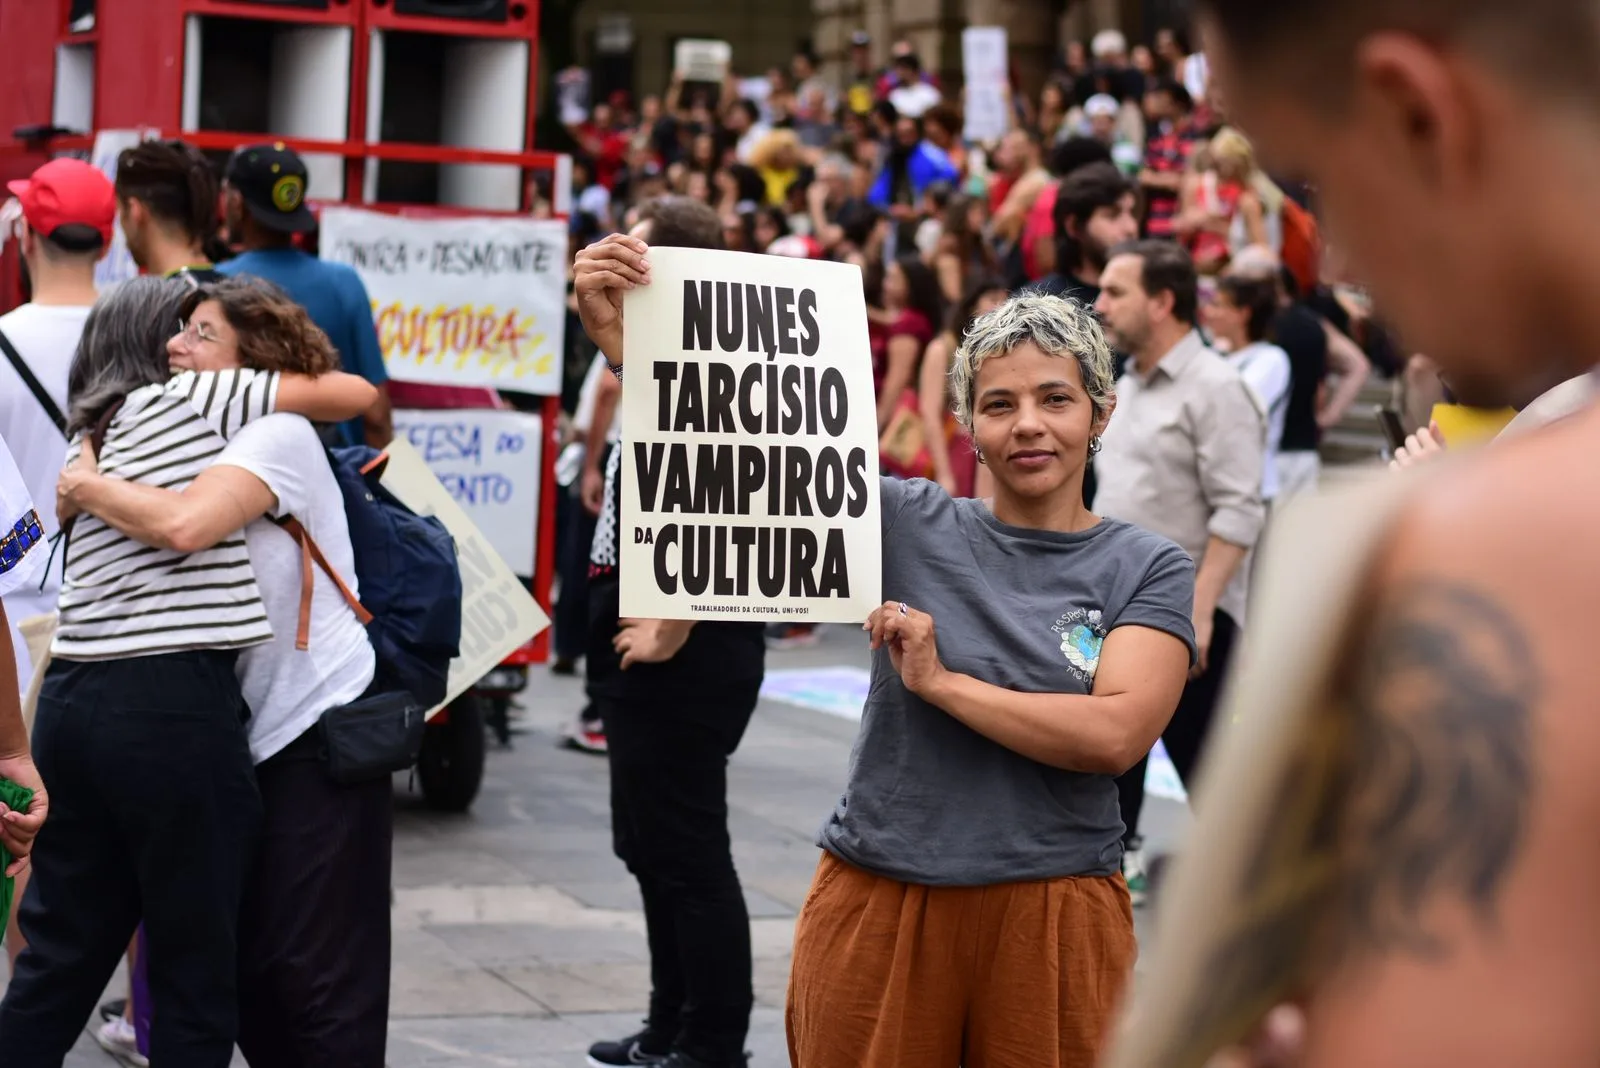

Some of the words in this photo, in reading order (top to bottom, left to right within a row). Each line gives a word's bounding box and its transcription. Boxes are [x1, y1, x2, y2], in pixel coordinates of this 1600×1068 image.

[430, 240, 553, 279] DESMONTE
[374, 305, 530, 360] CULTURA
[683, 280, 819, 356] NUNES
[654, 345, 847, 437] TARCÍSIO
[634, 442, 867, 518] VAMPIROS
[634, 527, 654, 545] DA
[653, 524, 850, 599] CULTURA
[690, 604, 740, 614] TRABALHADORES
[742, 605, 751, 613] DA
[752, 606, 781, 615] CULTURA,
